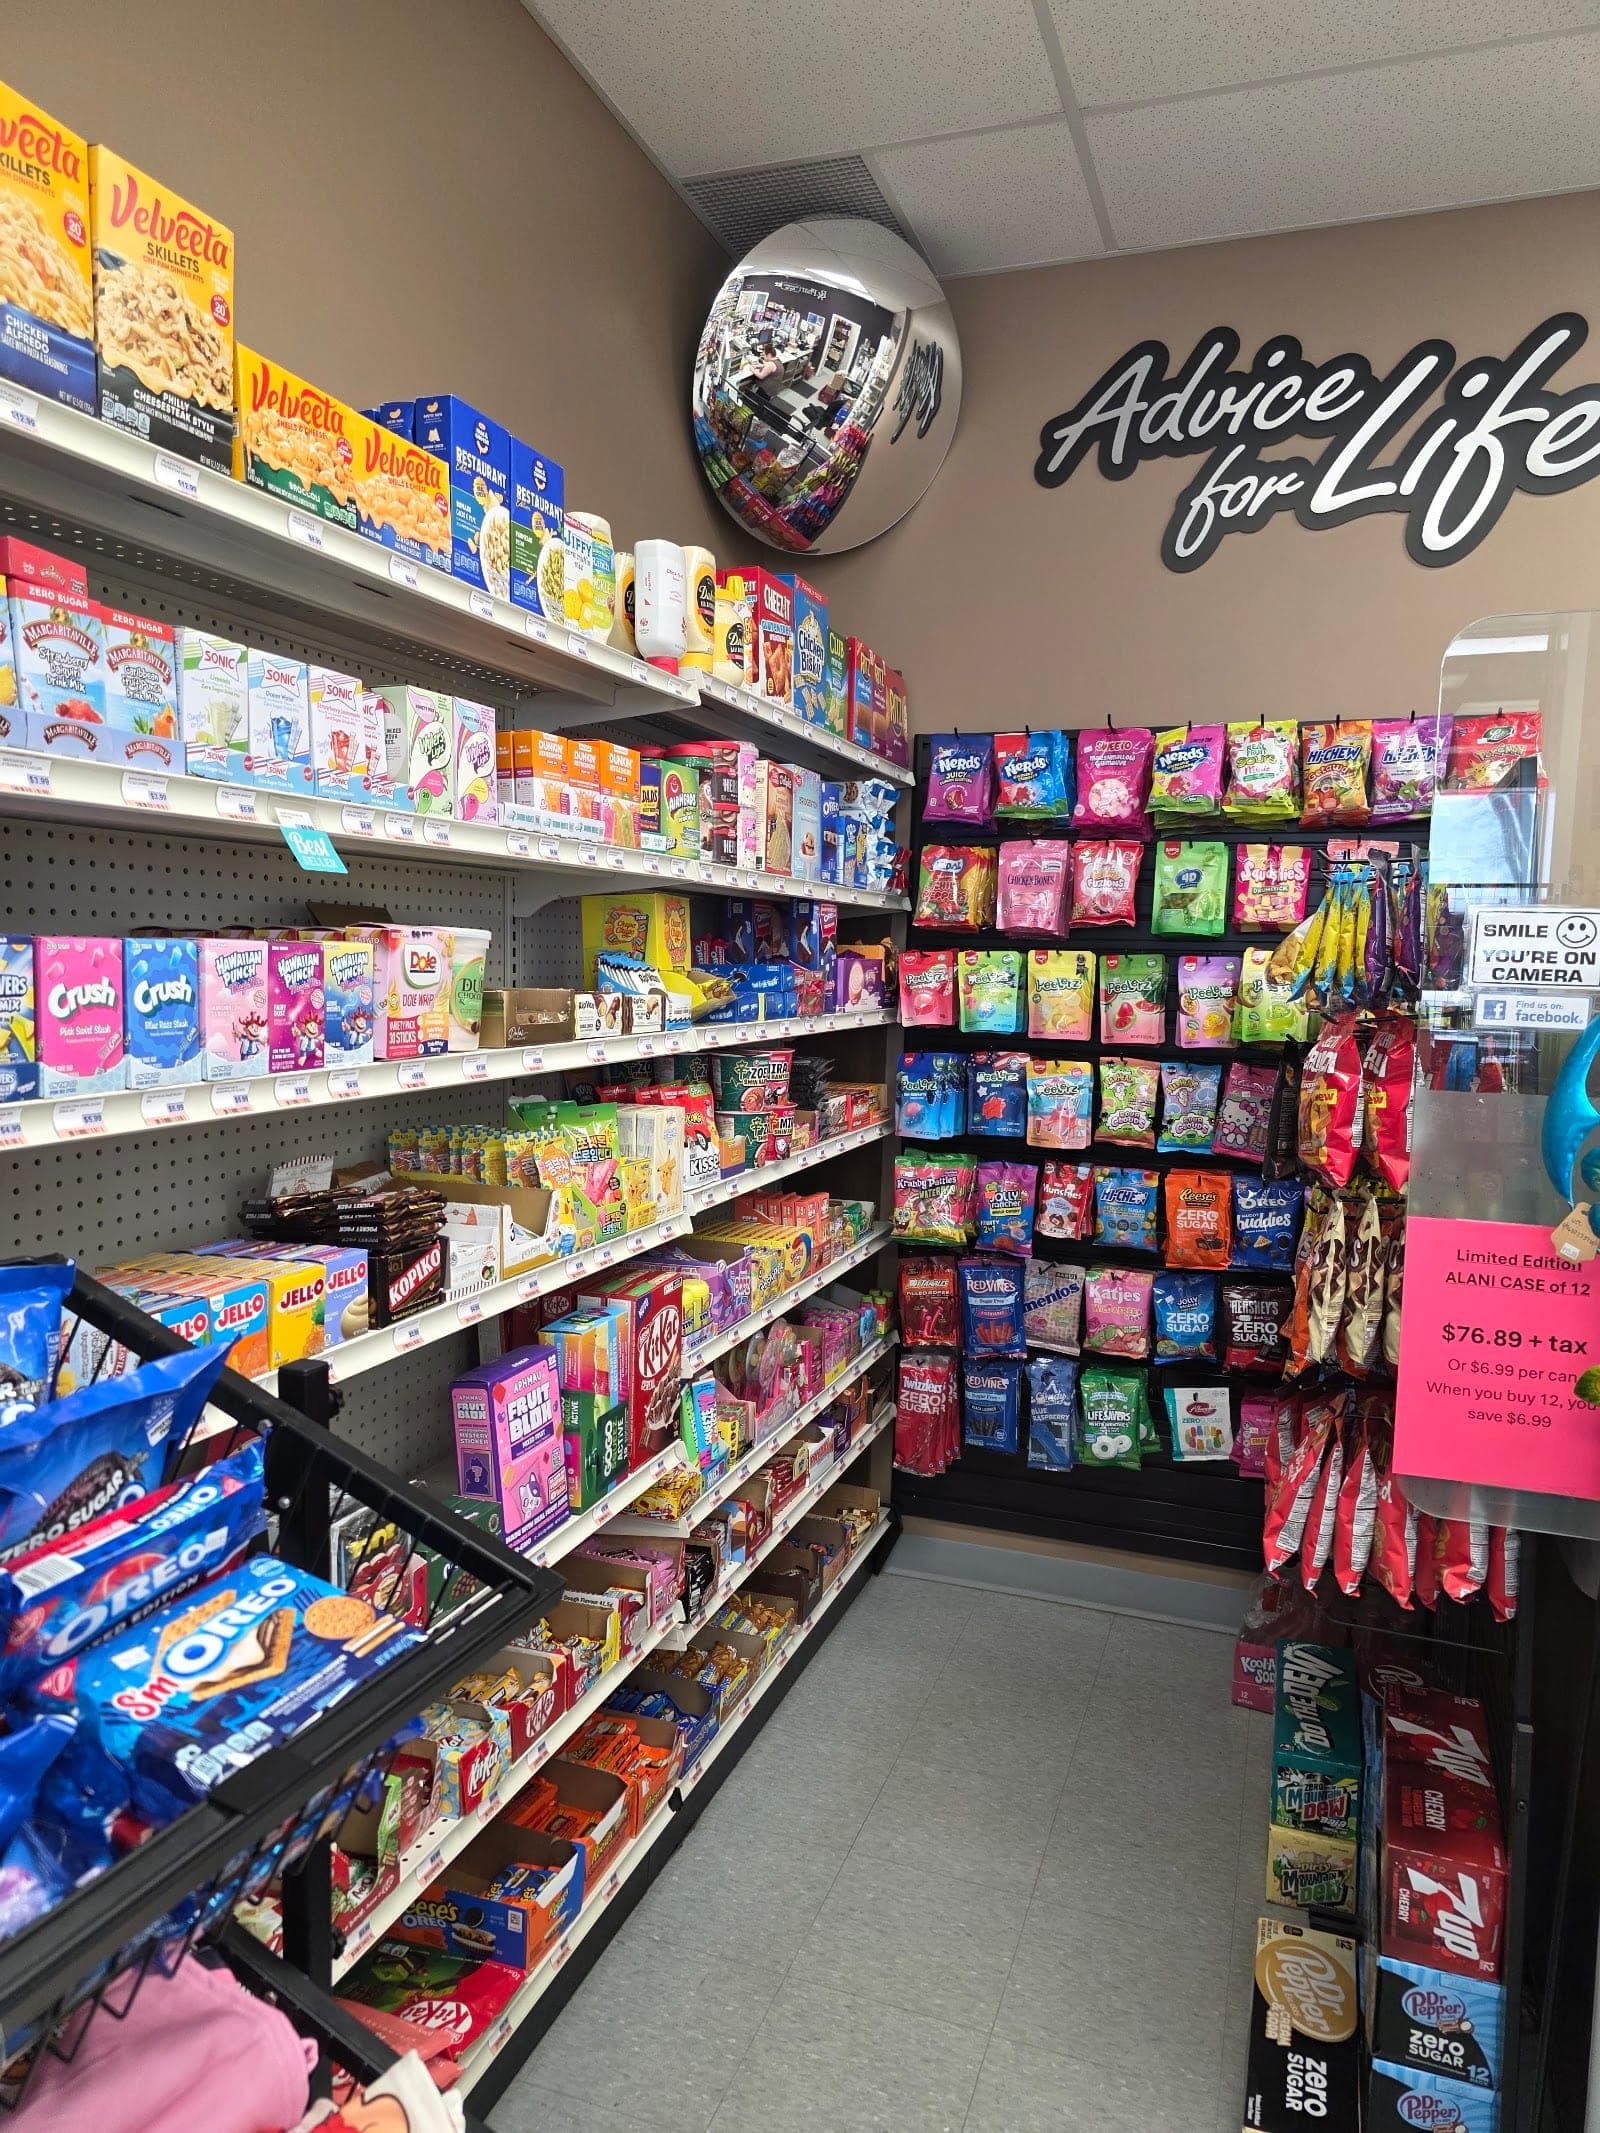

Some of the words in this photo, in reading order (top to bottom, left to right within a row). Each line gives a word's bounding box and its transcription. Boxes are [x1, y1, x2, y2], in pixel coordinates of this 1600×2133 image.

[0, 115, 81, 183] veeta
[111, 173, 229, 269] Velveeta
[147, 242, 200, 273] SKILLETS
[5, 313, 49, 344] CHICKEN
[6, 325, 50, 354] ALFREDO
[162, 393, 190, 411] PHILLY
[252, 361, 345, 437] Velveeta
[1046, 341, 1365, 473] Advice
[133, 388, 190, 423] CHEESESTEAK
[192, 416, 215, 435] STYLE
[1174, 443, 1304, 557] for
[1309, 328, 1600, 552] Life
[365, 428, 441, 490] Velveeta
[456, 447, 507, 490] RESTAURANT
[516, 484, 563, 523] RESTAURANT
[565, 529, 592, 556] JIFFY
[29, 587, 54, 600] ZERO
[58, 593, 88, 609] SUGAR
[113, 613, 134, 626] ZERO
[137, 619, 163, 634] SUGAR
[24, 622, 98, 657] MARGARITAVILLE
[799, 630, 824, 659] Chicken
[39, 646, 90, 671] Strawberry
[108, 646, 172, 680] MARGARITAVILLE
[204, 650, 236, 670] SONIC
[124, 665, 159, 683] Caribbean
[265, 667, 297, 687] SONIC
[326, 683, 353, 701] SONIC
[45, 724, 97, 748] MARGARITAVILLE
[127, 741, 172, 763] MARGARITAVILLE
[539, 740, 563, 755] DUNKIN'
[573, 749, 597, 764] DUNKIN'
[1307, 745, 1363, 765] HI-CHEW
[608, 753, 633, 768] DUNKIN'
[1483, 924, 1549, 938] SMILE
[215, 950, 263, 972] HAWAIIAN
[277, 953, 320, 976] HAWAIIAN
[329, 952, 368, 974] HAWAIIAN
[410, 951, 437, 969] Dole
[1483, 949, 1558, 964] YOU'RE
[1564, 951, 1597, 965] ON
[224, 966, 256, 984] PUNCH
[285, 969, 314, 985] PUNCH
[336, 967, 363, 985] PUNCH
[1491, 967, 1583, 982] CAMERA
[48, 974, 116, 1019] Crush
[134, 974, 192, 1014] Crush
[1516, 1000, 1535, 1009] Find
[1110, 1114, 1148, 1128] CLOUDS
[1118, 1110, 1141, 1119] SOUR
[1175, 1121, 1211, 1133] CLOUDS
[897, 1178, 928, 1191] Krabby
[928, 1176, 957, 1190] Patties
[1043, 1183, 1082, 1200] Munchies
[990, 1190, 1019, 1203] JOLLY
[991, 1200, 1021, 1209] rancher
[1101, 1187, 1149, 1205] HI-CHEW
[1179, 1188, 1217, 1202] Reese's
[1176, 1209, 1219, 1222] ZERO
[1176, 1220, 1218, 1231] SUGAR
[1236, 1211, 1291, 1231] buddies
[1457, 1249, 1518, 1266] Limited
[1523, 1255, 1582, 1272] Edition
[328, 1261, 367, 1290] JELL-O
[389, 1245, 441, 1308] KOPIKO
[966, 1280, 988, 1293] RED
[987, 1279, 1016, 1293] VINES
[1446, 1271, 1495, 1287] ALANI
[1500, 1276, 1545, 1292] CASE
[1550, 1281, 1567, 1293] of
[1572, 1283, 1590, 1296] 12
[280, 1278, 324, 1309] JELL-O
[1023, 1281, 1081, 1313] mentos
[1089, 1284, 1141, 1304] Katjes
[214, 1294, 264, 1327] JELL-O
[1166, 1312, 1210, 1324] ZERO
[1231, 1300, 1279, 1315] HERSHEY'S
[1166, 1323, 1209, 1333] SUGAR
[1231, 1321, 1278, 1334] ZERO
[1232, 1332, 1278, 1343] SUGAR
[1442, 1322, 1522, 1348] $76.89
[1529, 1335, 1542, 1348] +
[1549, 1336, 1588, 1355] tax
[641, 1316, 678, 1373] KitKat
[1448, 1358, 1466, 1372] Or
[1470, 1361, 1514, 1377] $6.99
[1518, 1368, 1544, 1380] per
[1548, 1371, 1577, 1383] can
[513, 1374, 542, 1392] APHMAU
[903, 1376, 943, 1394] Twizzlers
[966, 1376, 981, 1389] RED
[980, 1377, 1008, 1389] VINES
[507, 1384, 551, 1419] FRUIT
[1426, 1381, 1471, 1397] When
[1475, 1388, 1502, 1401] you
[1507, 1385, 1536, 1407] buy
[1541, 1394, 1563, 1408] 12,
[1567, 1398, 1597, 1411] you
[457, 1403, 485, 1412] FRUIT
[900, 1401, 940, 1415] SUGAR
[1031, 1407, 1047, 1416] BLUE
[1032, 1413, 1070, 1421] RASPBERRY
[1467, 1409, 1503, 1422] save
[1507, 1411, 1552, 1428] $6.99
[1182, 1417, 1201, 1425] ZERO
[3, 1521, 66, 1562] ZERO
[67, 1470, 125, 1532] SUGAR
[151, 1485, 218, 1531] OREO
[43, 1543, 207, 1658] OREO
[162, 1577, 298, 1674] OREO
[1282, 1648, 1345, 1696] DEW
[1290, 1696, 1321, 1722] THE
[1301, 1722, 1331, 1748] DO
[1424, 1789, 1447, 1832] CHERRY
[1301, 1861, 1331, 1873] Dirty
[1398, 1887, 1411, 1923] CHERRY
[402, 1915, 447, 1928] OREO
[1275, 1950, 1339, 2033] Pepper
[1422, 1990, 1448, 2006] Dr
[1411, 1993, 1463, 2020] Pepper
[1409, 2028, 1466, 2057] zero
[1408, 2044, 1465, 2068] SUGAR
[1285, 2051, 1305, 2113] SUGAR
[1467, 2064, 1490, 2082] 12
[1303, 2056, 1328, 2118] zero
[1406, 2096, 1458, 2123] Pepper
[1422, 2095, 1443, 2111] Dr
